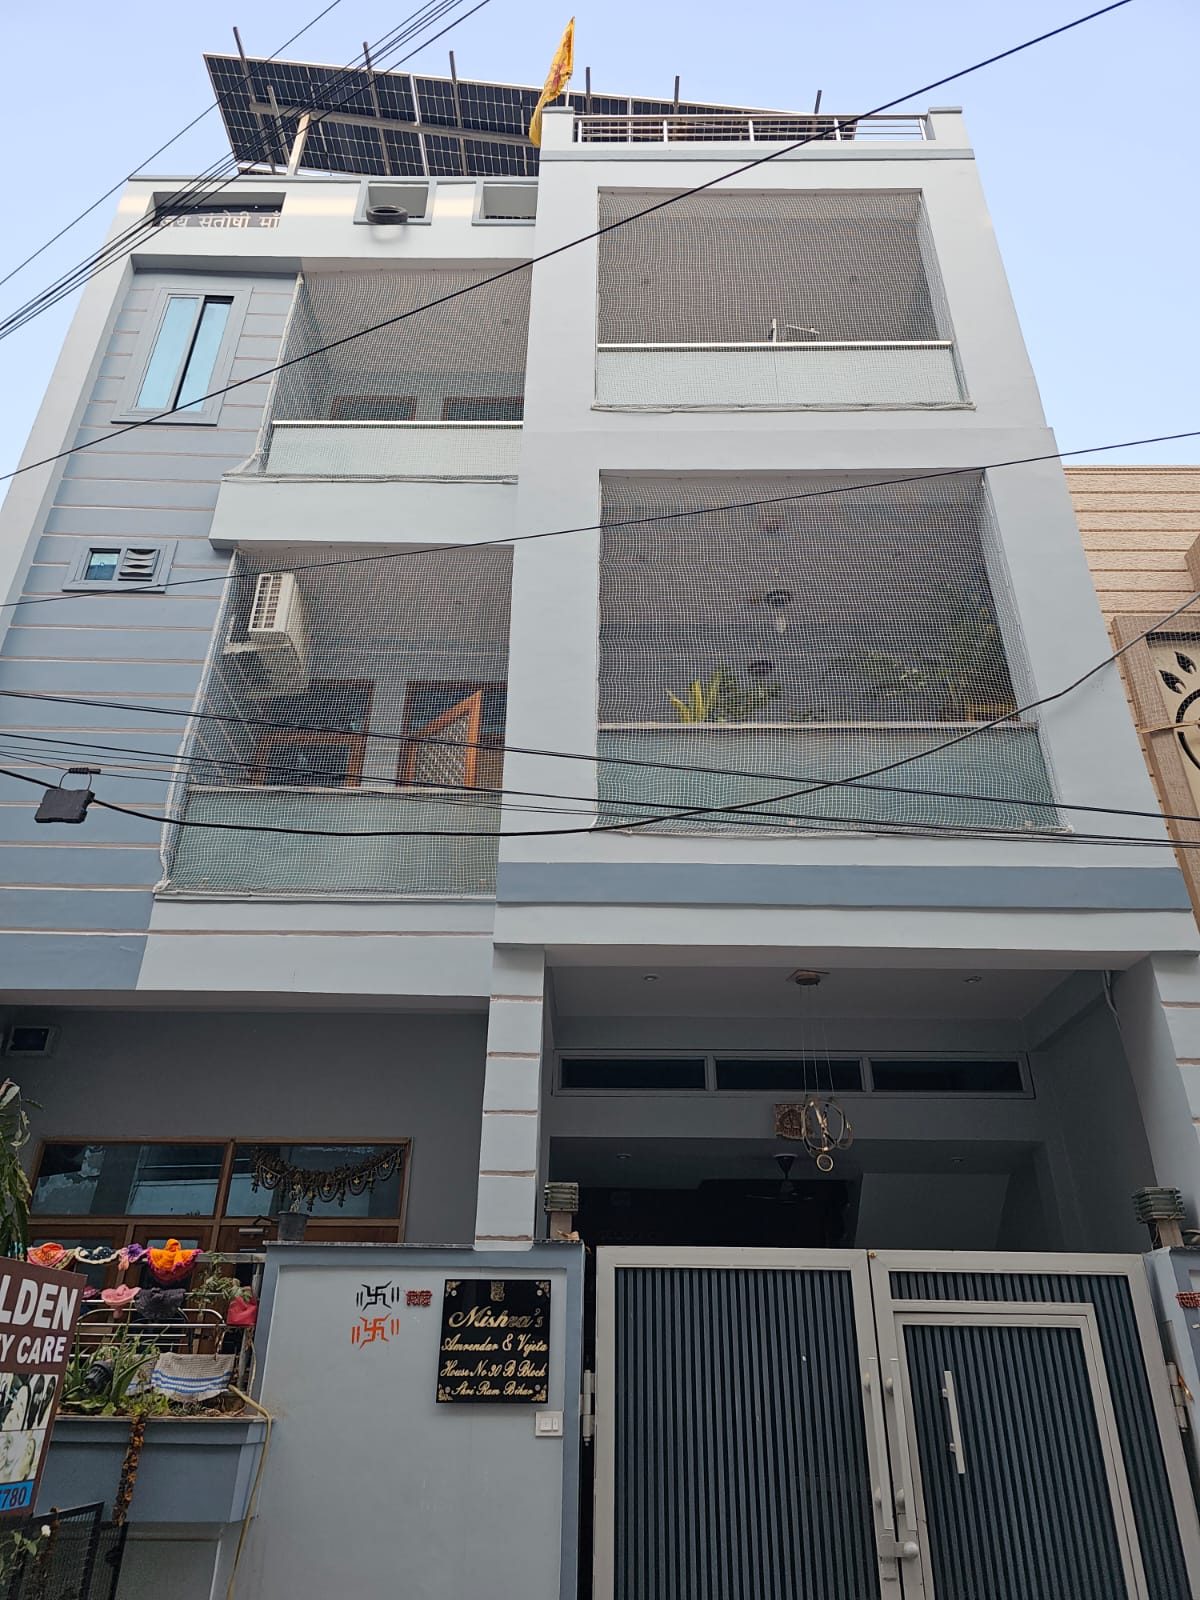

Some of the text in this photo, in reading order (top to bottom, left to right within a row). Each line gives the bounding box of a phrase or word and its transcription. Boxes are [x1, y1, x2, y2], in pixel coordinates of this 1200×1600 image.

[199, 209, 250, 228] संतोषी
[16, 1335, 67, 1364] CARE
[502, 1333, 514, 1351] &
[440, 1360, 470, 1377] House
[470, 1360, 488, 1377] No
[502, 1360, 517, 1377] B
[517, 1360, 548, 1377] Block
[451, 1380, 477, 1395] Shri
[475, 1380, 501, 1396] Ram
